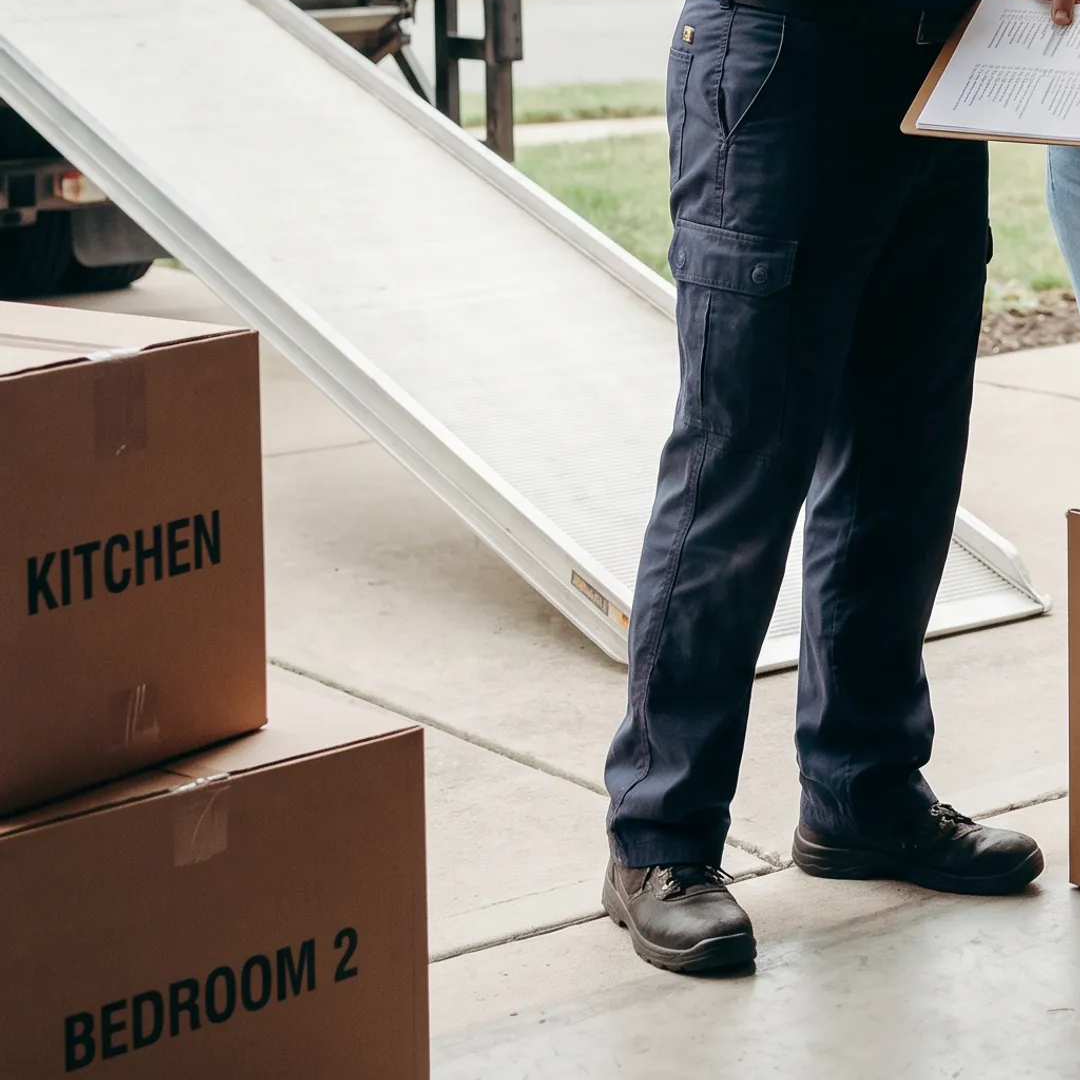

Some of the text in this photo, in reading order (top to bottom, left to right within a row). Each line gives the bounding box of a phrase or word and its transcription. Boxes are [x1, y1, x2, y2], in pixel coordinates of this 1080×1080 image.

[27, 509, 222, 616] KITCHEN
[64, 926, 359, 1073] BEDROOM 2
